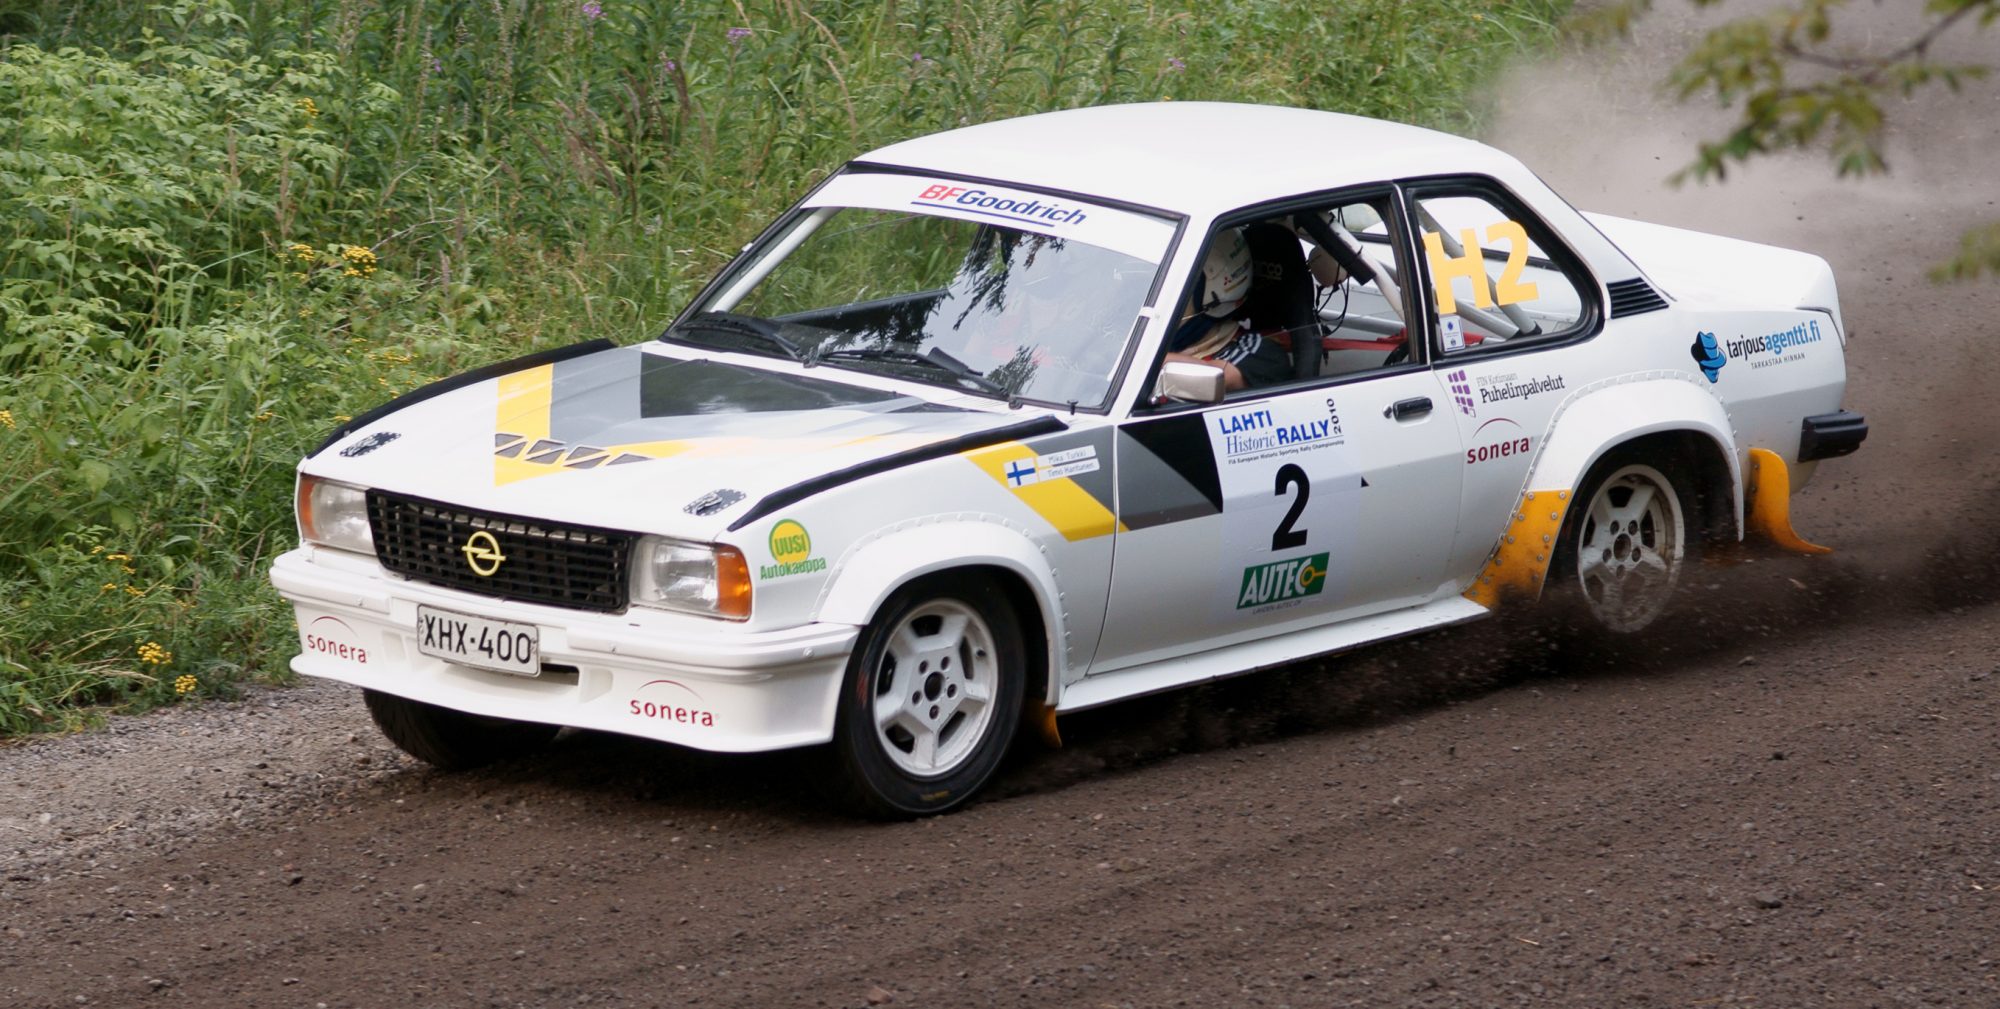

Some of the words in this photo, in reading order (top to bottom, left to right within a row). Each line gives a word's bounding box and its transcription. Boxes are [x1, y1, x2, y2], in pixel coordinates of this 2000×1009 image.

[918, 184, 1087, 225] BFGoodrich
[1422, 220, 1539, 314] H2
[1726, 320, 1822, 361] tarjousagentti.fi
[1751, 358, 1782, 370] TARKASTAA
[1784, 352, 1805, 363] HINNAN
[1480, 374, 1565, 403] Puhelinpalvelut
[1219, 410, 1272, 434] LAHTI
[1327, 398, 1342, 435] 2010
[1226, 432, 1276, 455] Historic
[1276, 420, 1328, 445] RALLY
[1237, 454, 1259, 464] European
[1260, 451, 1278, 460] Historic
[1280, 447, 1299, 457] Sporting
[1300, 444, 1311, 452] Rally
[1312, 439, 1345, 450] Championship
[1467, 436, 1530, 464] sonera
[1271, 463, 1310, 551] 2
[774, 533, 806, 556] UUSI
[760, 556, 827, 579] Autokauppa
[1240, 557, 1312, 606] AUTEC
[307, 633, 367, 664] sonera
[630, 699, 713, 727] sonera
